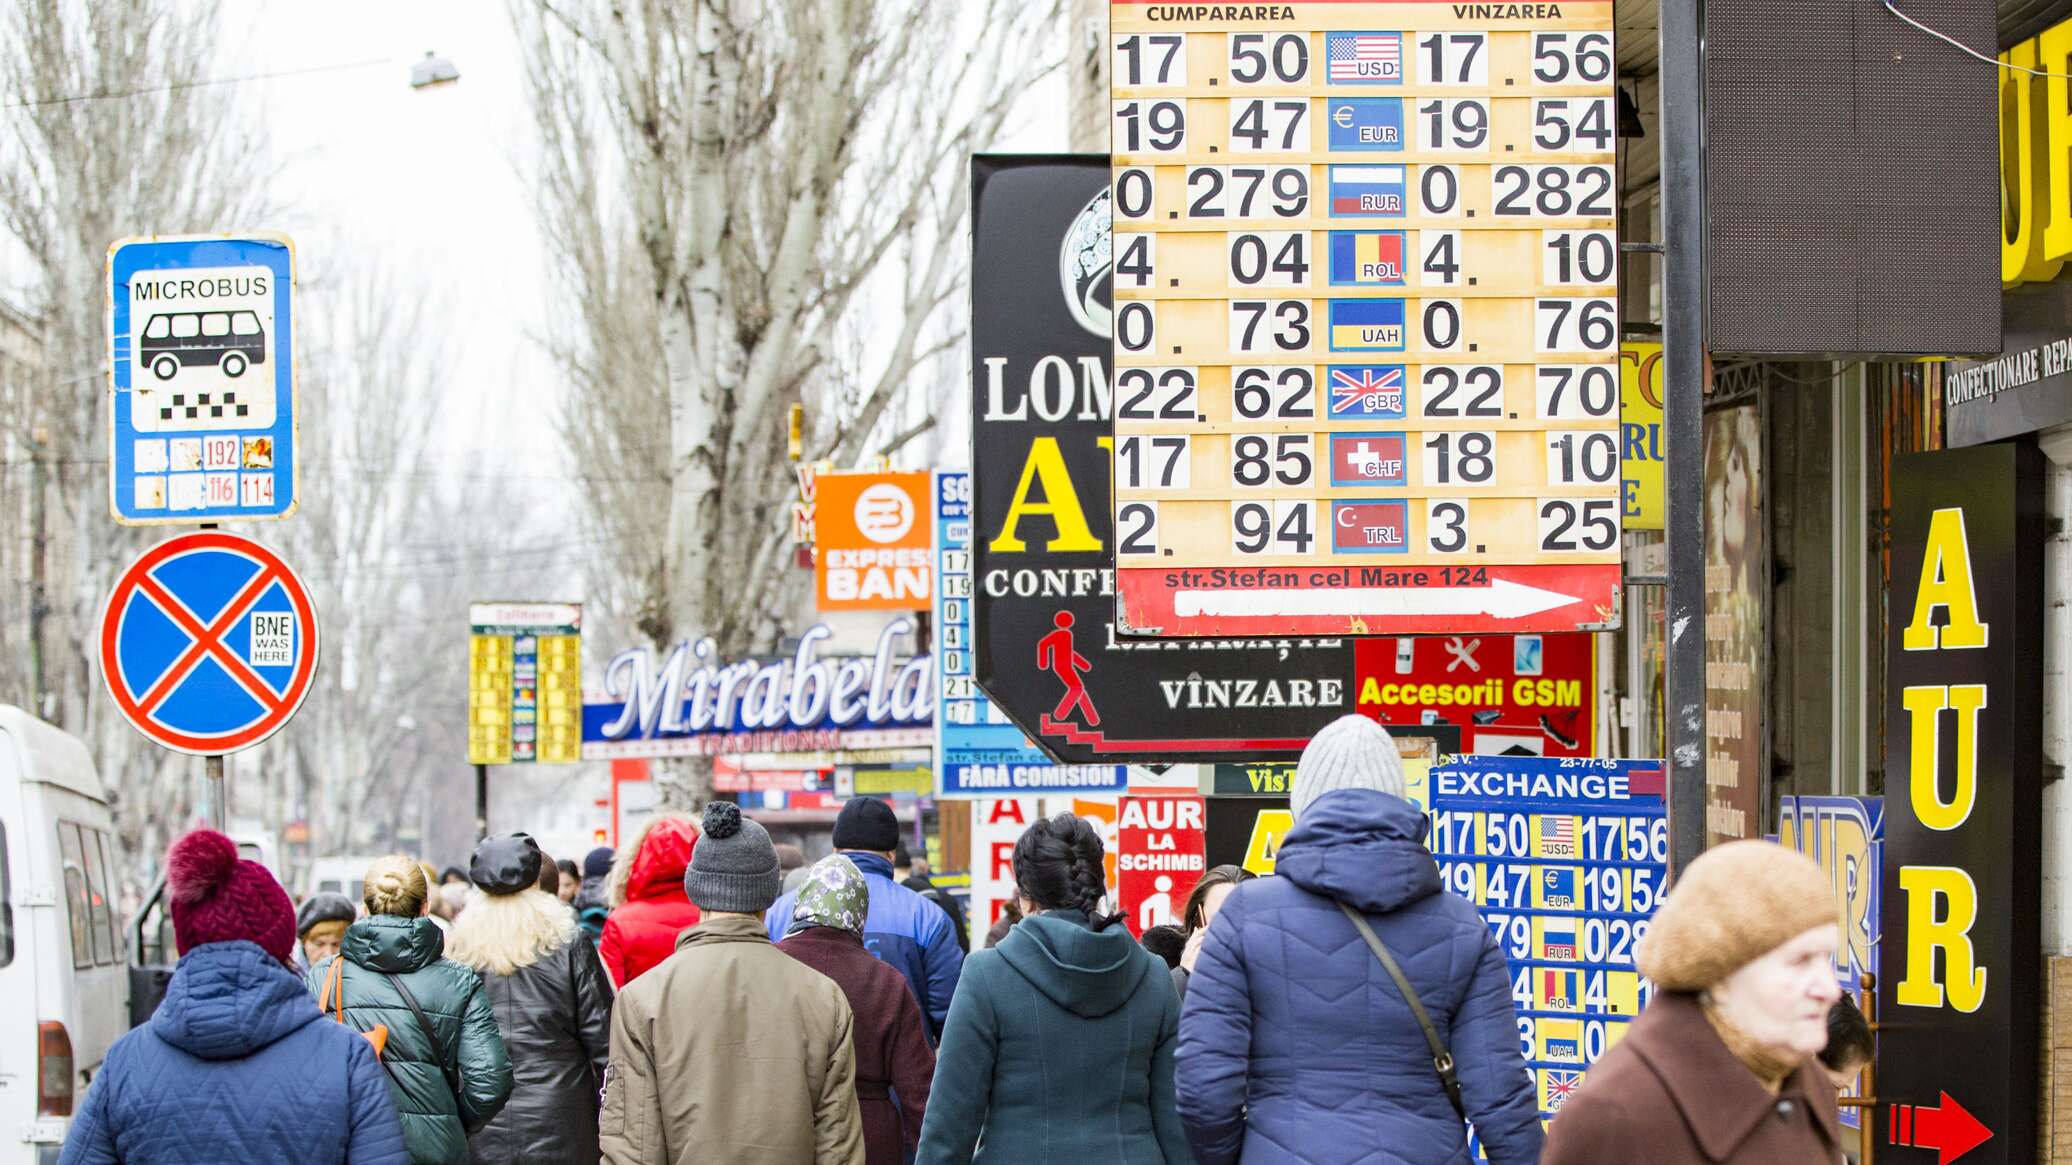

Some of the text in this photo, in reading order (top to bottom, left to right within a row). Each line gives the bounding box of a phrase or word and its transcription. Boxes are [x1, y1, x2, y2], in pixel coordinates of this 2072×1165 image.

[1147, 4, 1561, 21] CUMPARAREA VINZAREA
[1357, 61, 1394, 76] USD
[1360, 127, 1397, 141] EUR
[1361, 194, 1400, 210] RUR
[1363, 263, 1398, 278] ROL
[136, 276, 267, 301] MICROBUS
[1362, 329, 1398, 343] UAH
[1364, 394, 1400, 409] GBP
[207, 440, 236, 465] 192
[1365, 461, 1400, 476] CHF
[210, 477, 272, 503] 116 114
[1365, 527, 1400, 543] TRL
[826, 549, 933, 567] EXPRES
[1310, 568, 1349, 587] cel
[1361, 568, 1428, 586] Mare
[1440, 567, 1487, 586] 124
[255, 616, 289, 637] BNE
[255, 638, 289, 650] WAS
[254, 651, 289, 663] HERE
[600, 617, 934, 738] Mirabela
[1159, 671, 1342, 708] VÎNZARE
[1359, 677, 1582, 707] Accesorii GSM
[1898, 507, 1989, 1014] AUR
[1438, 772, 1631, 800] EXCHANGE
[1119, 801, 1203, 830] AUR
[1147, 834, 1176, 850] LA
[1546, 844, 1569, 855] USD
[1119, 854, 1204, 871] SCHIMB
[1548, 896, 1571, 907] EUR
[1549, 948, 1571, 959] RUR
[1550, 998, 1571, 1009] ROL
[1551, 1046, 1573, 1058] UAH
